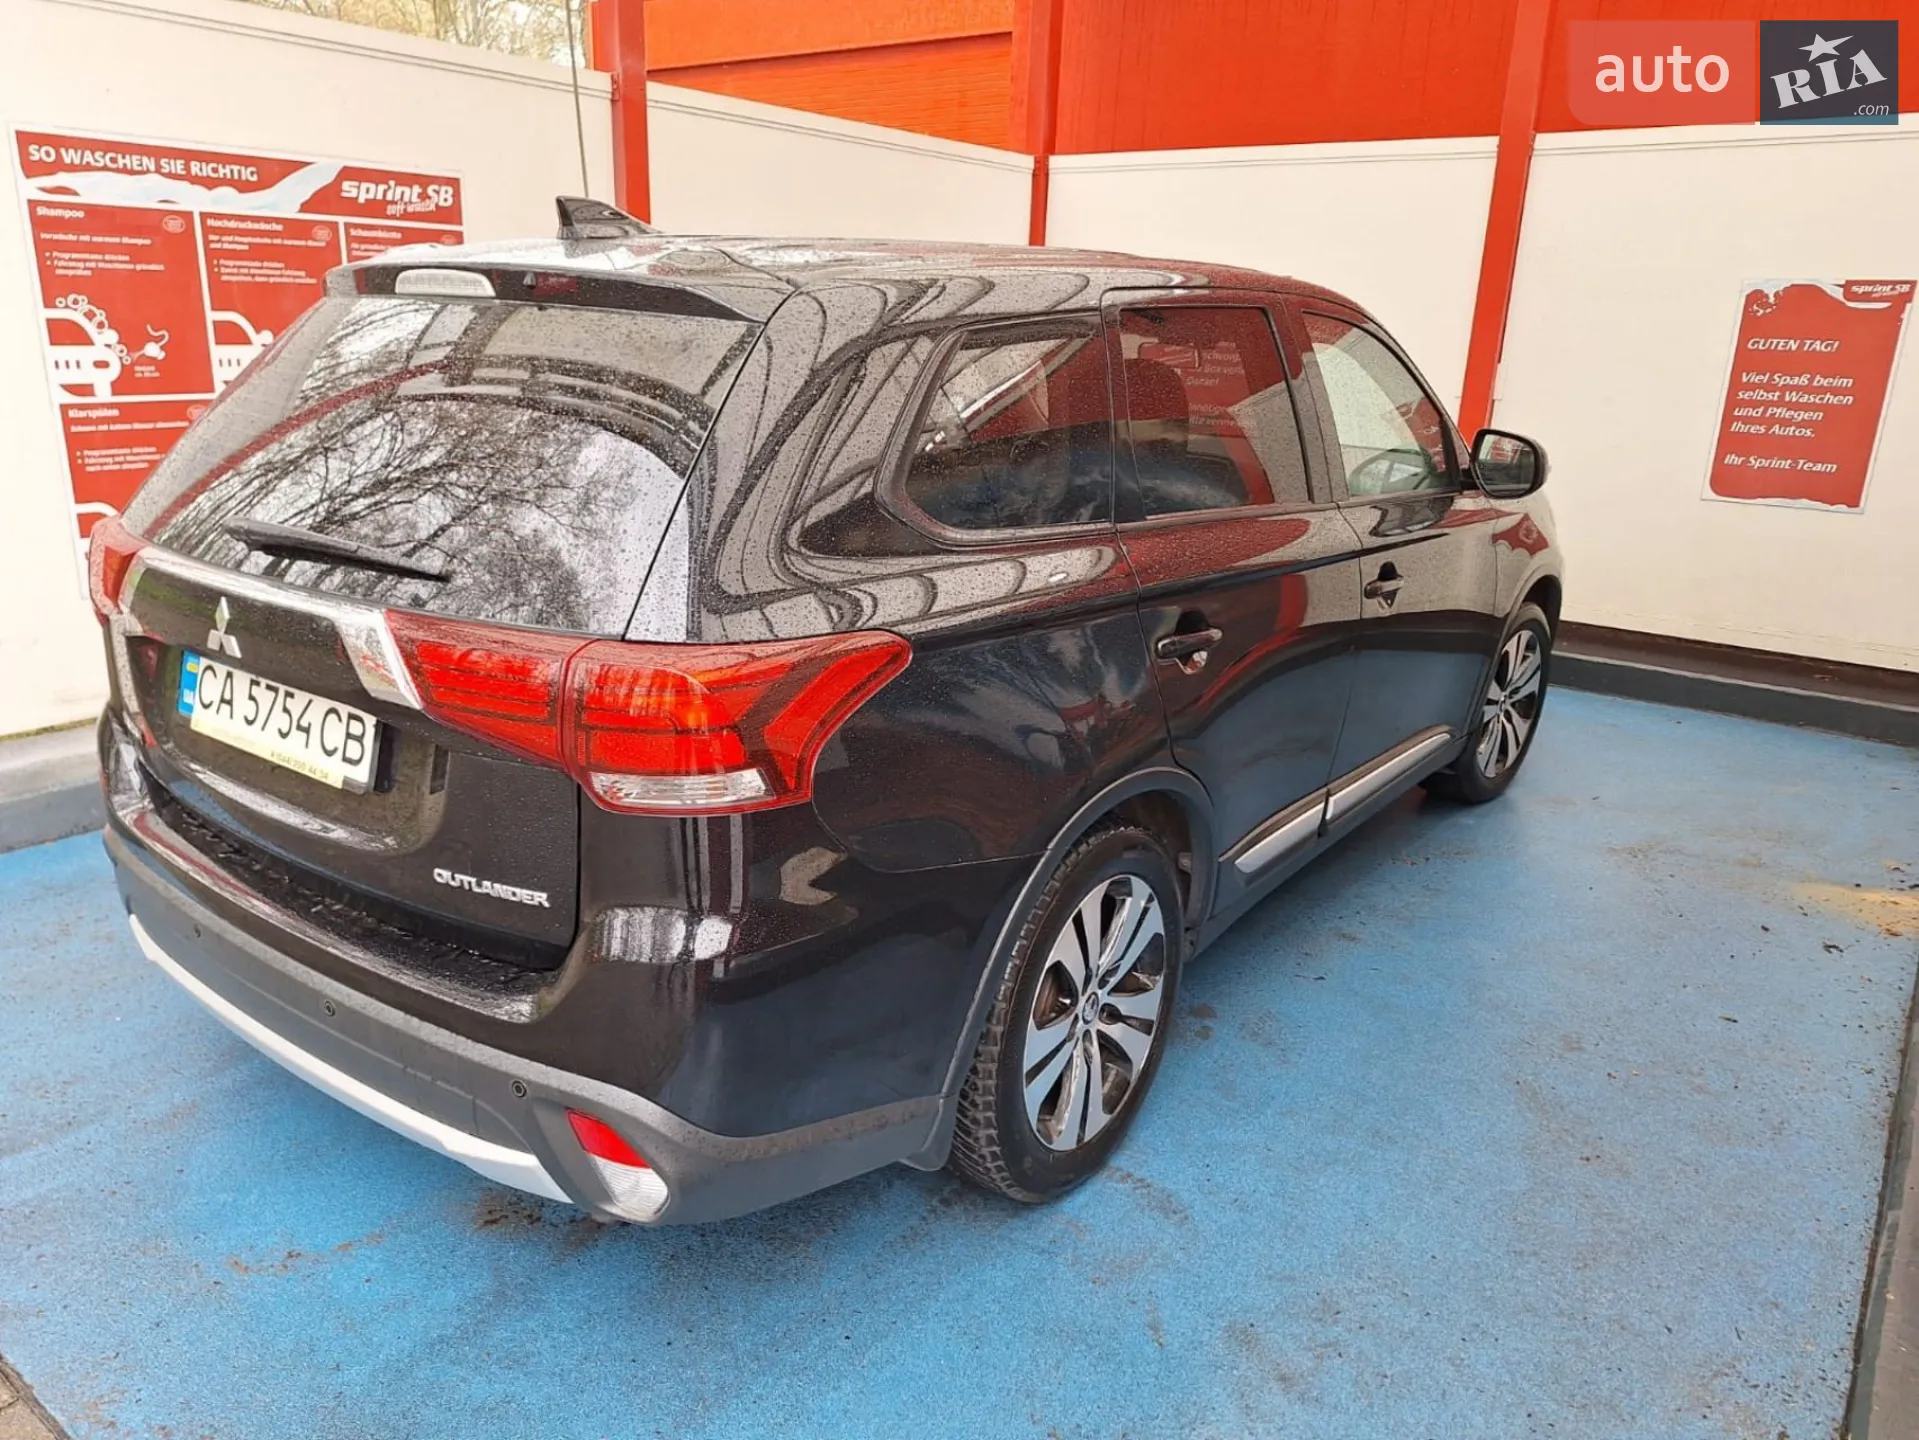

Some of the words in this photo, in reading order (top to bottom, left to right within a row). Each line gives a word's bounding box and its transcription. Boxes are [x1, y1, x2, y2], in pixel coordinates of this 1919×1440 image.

[28, 144, 56, 163] SO
[60, 147, 156, 172] WASCHEN
[160, 158, 187, 175] SIE
[190, 160, 258, 182] RICHTIG
[340, 179, 422, 204] sprint
[427, 184, 453, 207] SB
[36, 205, 85, 219] Shampoo
[1747, 338, 1800, 352] GUTEN
[1803, 340, 1839, 352] TAG!
[1741, 372, 1768, 384] Viel
[1771, 373, 1809, 387] Spaß
[1813, 375, 1854, 388] beim
[1736, 389, 1780, 401] selbst
[1784, 390, 1854, 405] Waschen
[1733, 405, 1763, 417] und
[1765, 406, 1824, 422] Pflegen
[1730, 421, 1766, 434] Ihres
[1768, 424, 1815, 437] Autos.
[1724, 453, 1745, 465] Ihr
[198, 664, 234, 720] CA
[243, 678, 314, 749] 5754
[320, 706, 367, 767] CB
[433, 867, 551, 908] OUTLANDER
